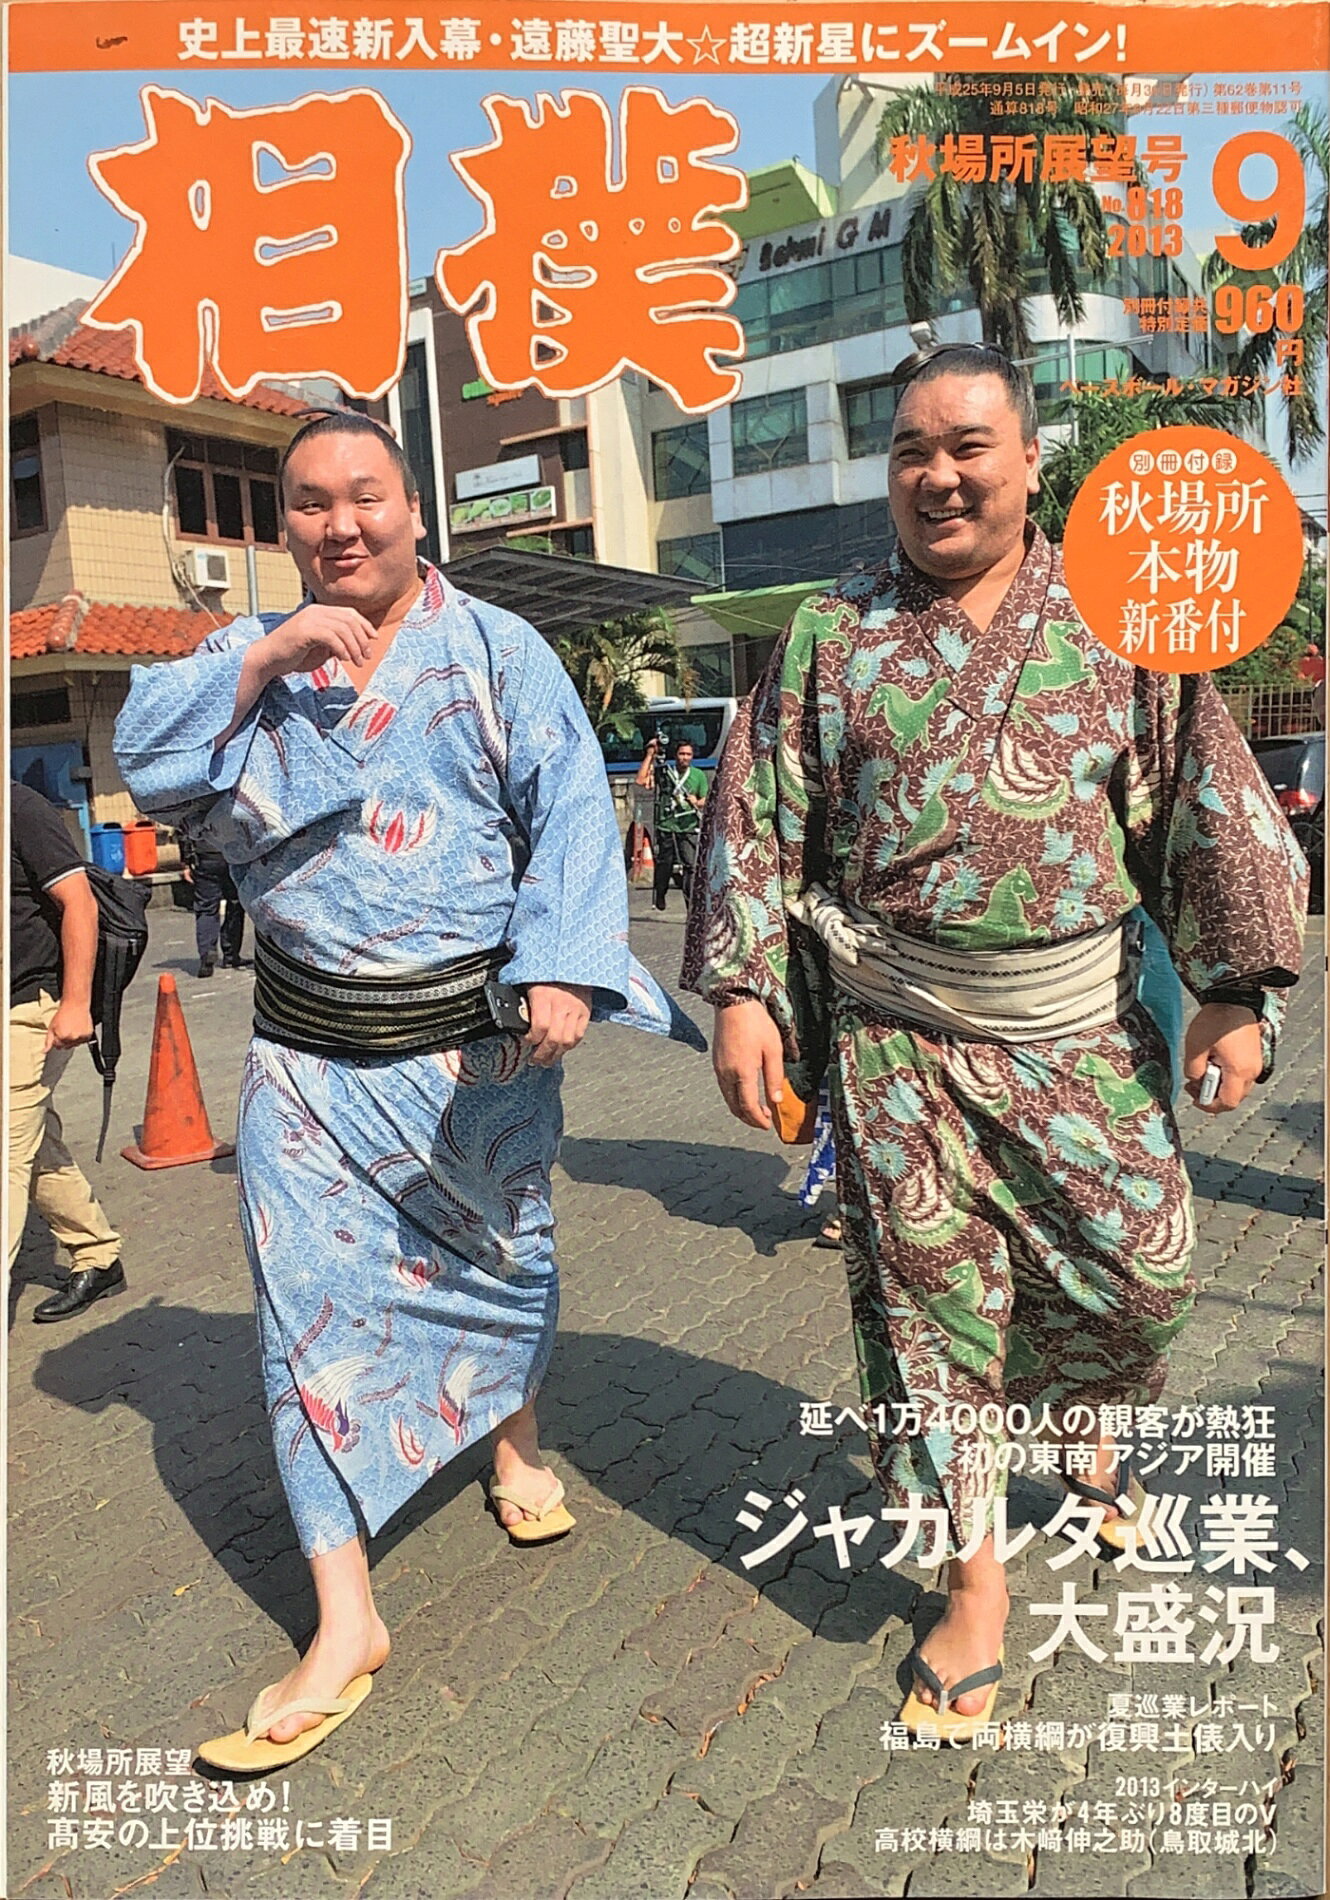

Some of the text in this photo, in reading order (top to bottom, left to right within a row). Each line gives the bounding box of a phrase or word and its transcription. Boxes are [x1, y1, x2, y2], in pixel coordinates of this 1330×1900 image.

[888, 133, 1189, 184] 秋場所展望号
[1211, 130, 1307, 271] 9
[78, 82, 749, 415] 相撲
[1107, 223, 1184, 257] 2013
[1214, 284, 1305, 334] 960
[1275, 338, 1305, 368] 円
[1130, 449, 1237, 475] 別冊付録
[1098, 478, 1270, 536] 秋場所
[1126, 538, 1240, 595] 本物
[1117, 598, 1248, 655] 新番付
[799, 1403, 1277, 1436] 延べ1万4000人の観客が熱狂
[957, 1442, 1277, 1477] 初の東南アジア開催
[1028, 1581, 1280, 1665] 大盛況
[1107, 1693, 1279, 1719] 夏巡業レポート
[46, 1747, 192, 1777] 秋場所展望
[47, 1780, 291, 1814] 新風を吹き込め!
[1115, 1775, 1279, 1799] 2013インターハイ
[966, 1799, 1277, 1827] 埼玉栄が4年ぶり8度目のV
